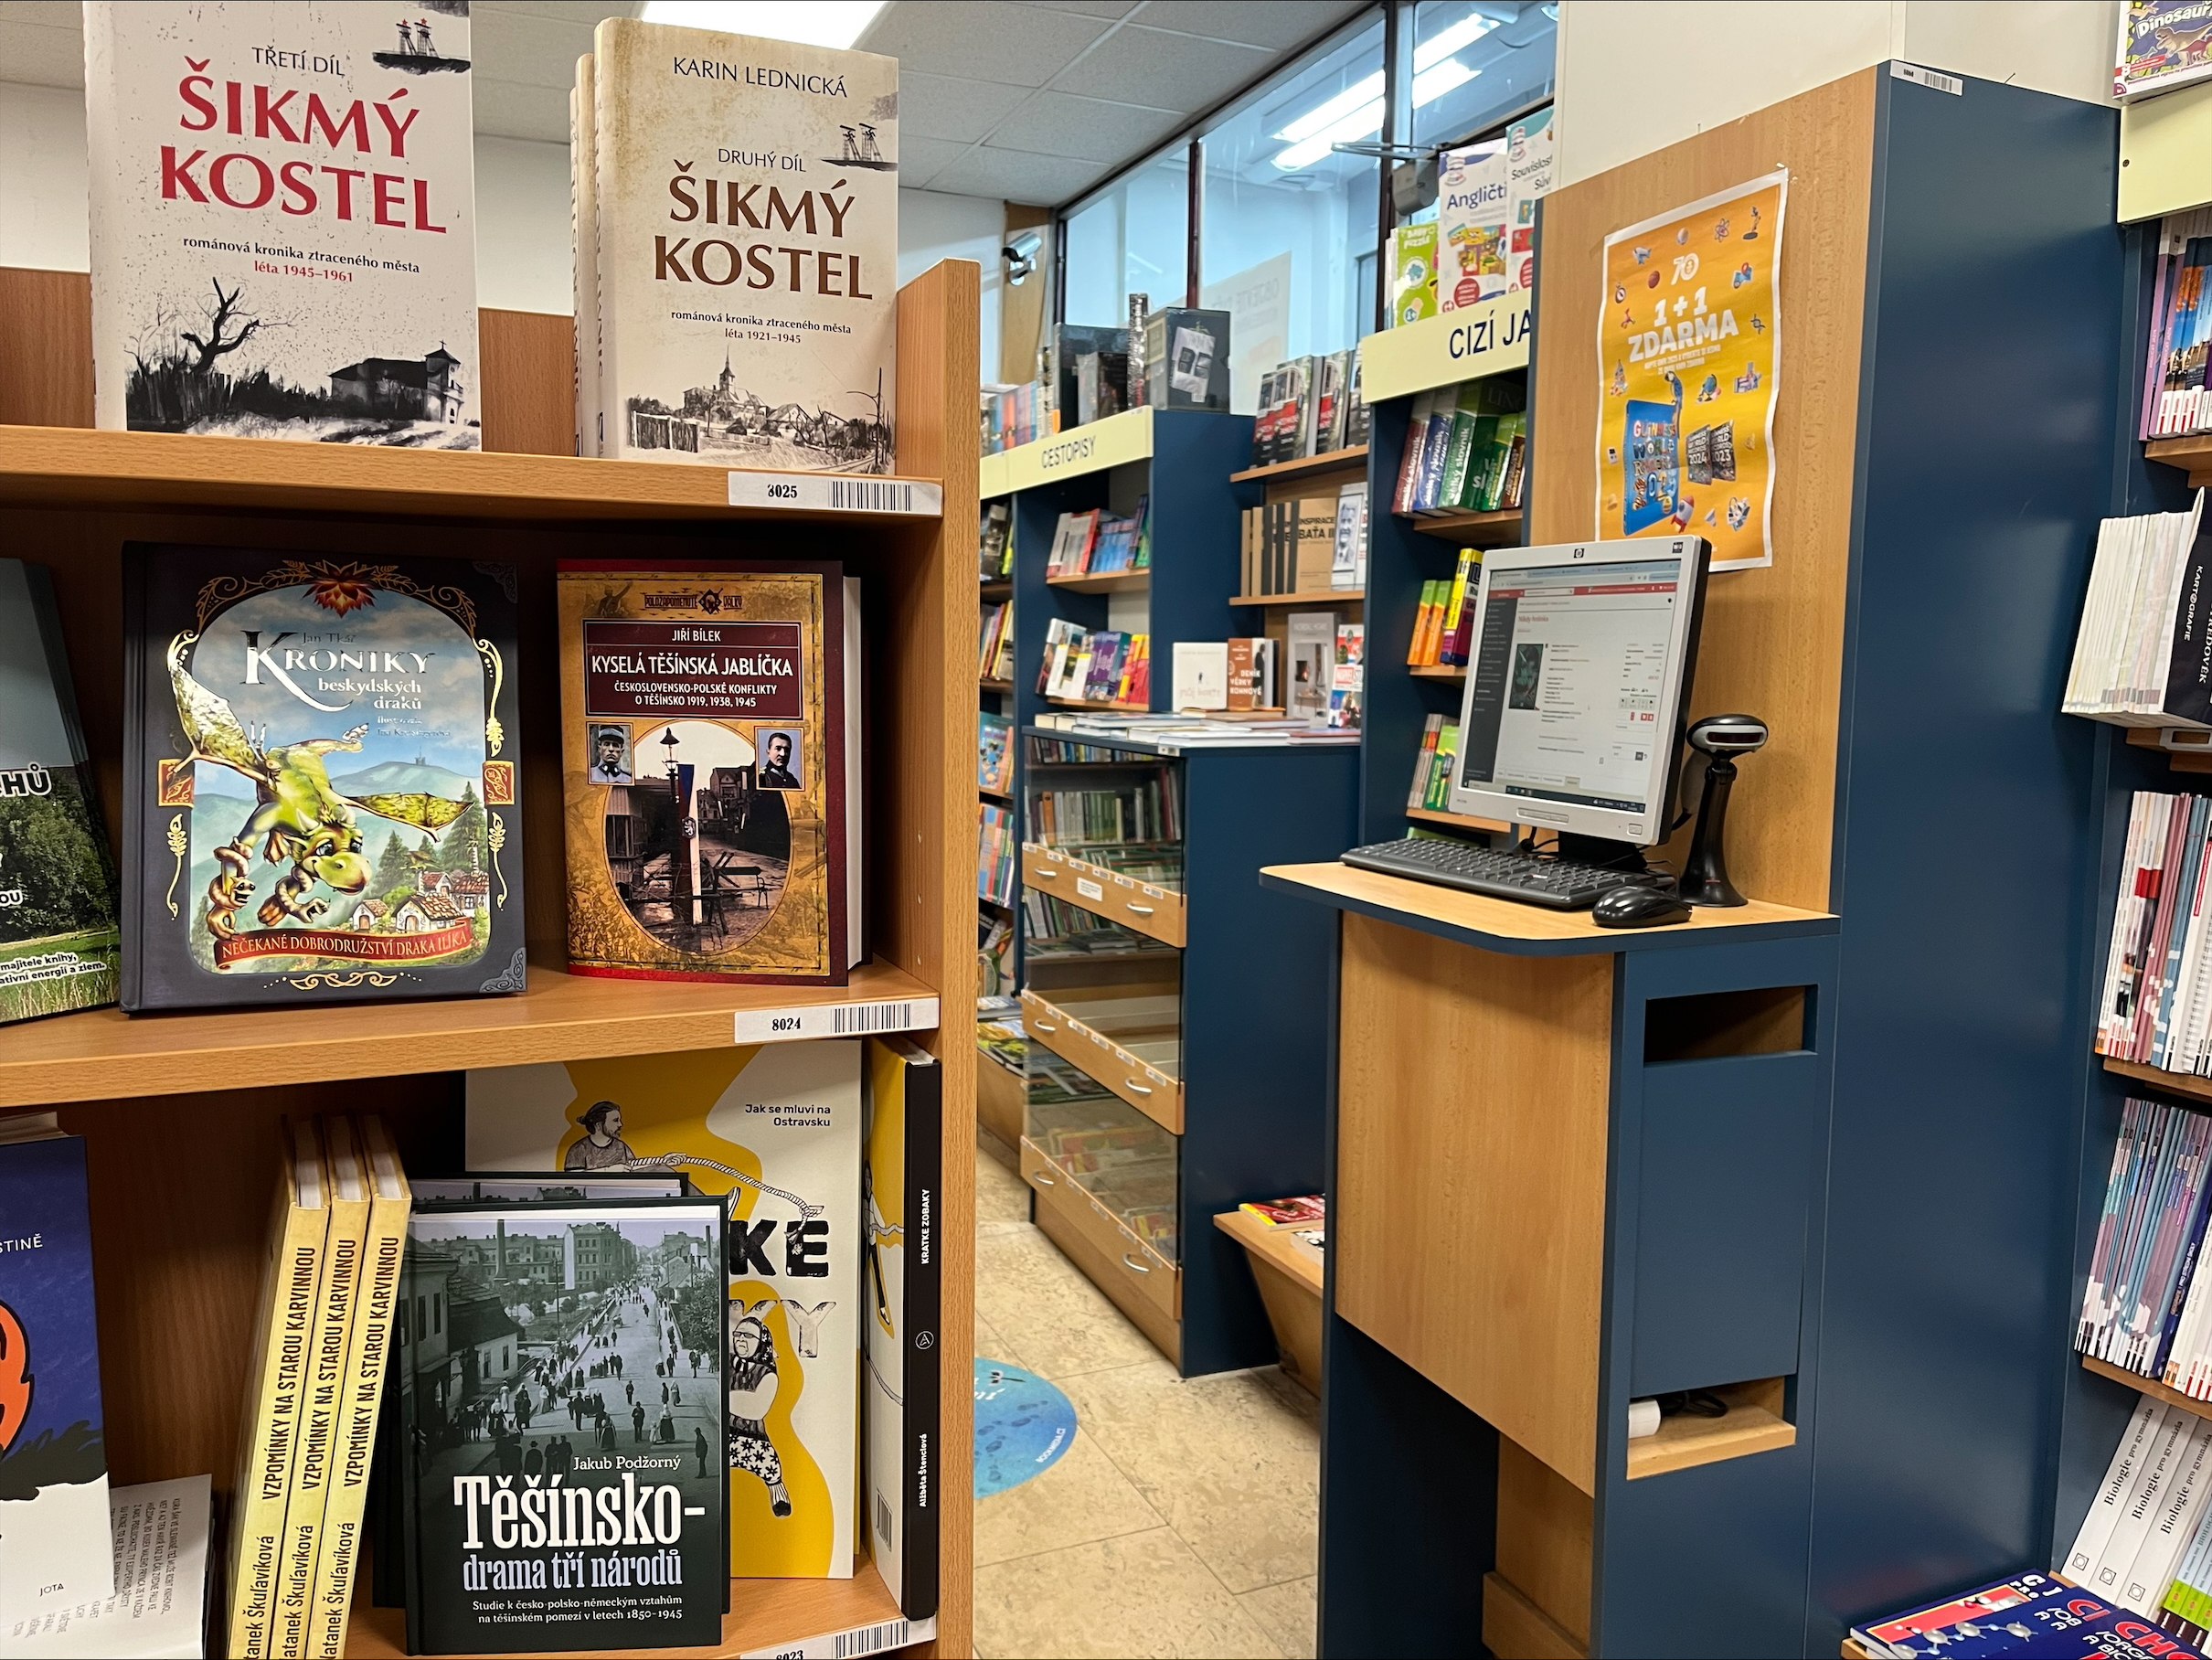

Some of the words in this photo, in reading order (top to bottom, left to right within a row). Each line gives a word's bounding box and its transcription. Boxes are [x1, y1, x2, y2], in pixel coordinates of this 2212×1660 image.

[251, 45, 307, 70] TŘETÍ
[313, 53, 346, 77] DÍL
[674, 57, 738, 83] KARIN
[745, 66, 847, 98] LEDNICKÁ
[179, 55, 420, 158] ŠIKMÝ
[718, 148, 776, 169] DRUHÝ
[782, 152, 806, 172] DÍL
[160, 144, 447, 234] KOSTEL
[669, 159, 856, 238] ŠIKMÝ
[183, 237, 250, 254] románová
[254, 242, 303, 260] kronika
[308, 249, 378, 269] ztraceného
[382, 258, 420, 273] města
[254, 261, 279, 274] léta
[654, 235, 873, 300] KOSTEL
[671, 310, 723, 325] románová
[726, 313, 763, 328] kronika
[766, 316, 820, 333] ztraceného
[823, 320, 852, 335] města
[725, 329, 743, 340] léta
[1450, 310, 1494, 359] CIZÍ
[1503, 310, 1531, 346] JA
[1628, 309, 1739, 363] ZDARMA
[1040, 435, 1097, 468] CESTOPISY
[672, 628, 690, 642] JIŘÍ
[693, 629, 721, 642] BÍLEK
[591, 652, 645, 675] KYSELÁ
[648, 652, 719, 676] TĚŠÍNSKÁ
[721, 654, 793, 676] JABLÍČKA
[318, 677, 421, 696] beskydských
[373, 696, 421, 709] draků
[614, 680, 727, 695] ČESKOSLOVENSKO-POLSKÉ
[728, 684, 777, 695] KONFLIKTY
[635, 696, 642, 706] O
[643, 693, 685, 706] TĚŠÍNSKO
[686, 697, 708, 707] 1919,
[710, 697, 733, 708] 1938,
[735, 697, 756, 707] 1945
[0, 763, 50, 795] HŮ
[221, 936, 288, 959] NEČEKANÉ
[290, 934, 393, 957] DOBRODRUŽSTVÍ
[396, 940, 436, 956] DRAKA
[438, 931, 467, 952] ILÍKA
[1, 959, 42, 972] majitele
[46, 953, 77, 965] knihy,
[32, 966, 69, 980] energií
[79, 963, 105, 973] zlem.
[771, 1016, 802, 1032] 8024
[745, 1103, 766, 1114] Jak
[769, 1106, 782, 1114] se
[784, 1103, 814, 1114] mluvi
[817, 1106, 831, 1114] na
[773, 1117, 831, 1127] Ostravsku
[921, 1189, 931, 1227] ZOBAKY
[728, 1218, 829, 1277] KE
[921, 1228, 930, 1265] KRATKE
[286, 1247, 315, 1330] KARVINNOU
[327, 1240, 356, 1321] KARVINNOU
[370, 1237, 399, 1319] KARVINNOU
[278, 1335, 303, 1389] STAROU
[318, 1326, 343, 1380] STAROU
[361, 1323, 385, 1378] STAROU
[274, 1394, 294, 1414] NA
[315, 1385, 335, 1404] NA
[357, 1381, 377, 1402] NA
[262, 1419, 291, 1500] VZPOMÍNKY
[303, 1410, 331, 1490] VZPOMÍNKY
[344, 1406, 373, 1487] VZPOMÍNKY
[573, 1456, 612, 1471] Jakub
[615, 1453, 682, 1472] Podžorný
[918, 1433, 927, 1475] Štenclová
[2104, 1459, 2132, 1506] Biologie
[2129, 1443, 2137, 1458] pro
[2135, 1409, 2154, 1444] gymnázia
[2132, 1472, 2161, 1520] Biologie
[2156, 1457, 2166, 1472] pro
[2164, 1421, 2183, 1457] gymnázia
[2160, 1486, 2189, 1535] Biologie
[2186, 1470, 2196, 1485] pro
[2193, 1433, 2212, 1471] gymnázia
[919, 1476, 927, 1507] Alžběta
[453, 1473, 706, 1549] Těšínsko-
[463, 1553, 547, 1591] drama
[551, 1549, 584, 1590] tří
[590, 1548, 683, 1588] národů
[39, 1582, 64, 1597] JOTA
[473, 1600, 505, 1612] Studie
[507, 1600, 514, 1611] k
[640, 1594, 683, 1606] vztahům
[478, 1613, 491, 1624] na
[494, 1612, 543, 1623] těšínském
[546, 1610, 581, 1625] pomezí
[584, 1612, 590, 1622] v
[592, 1610, 623, 1621] letech
[279, 1612, 302, 1659] atanek
